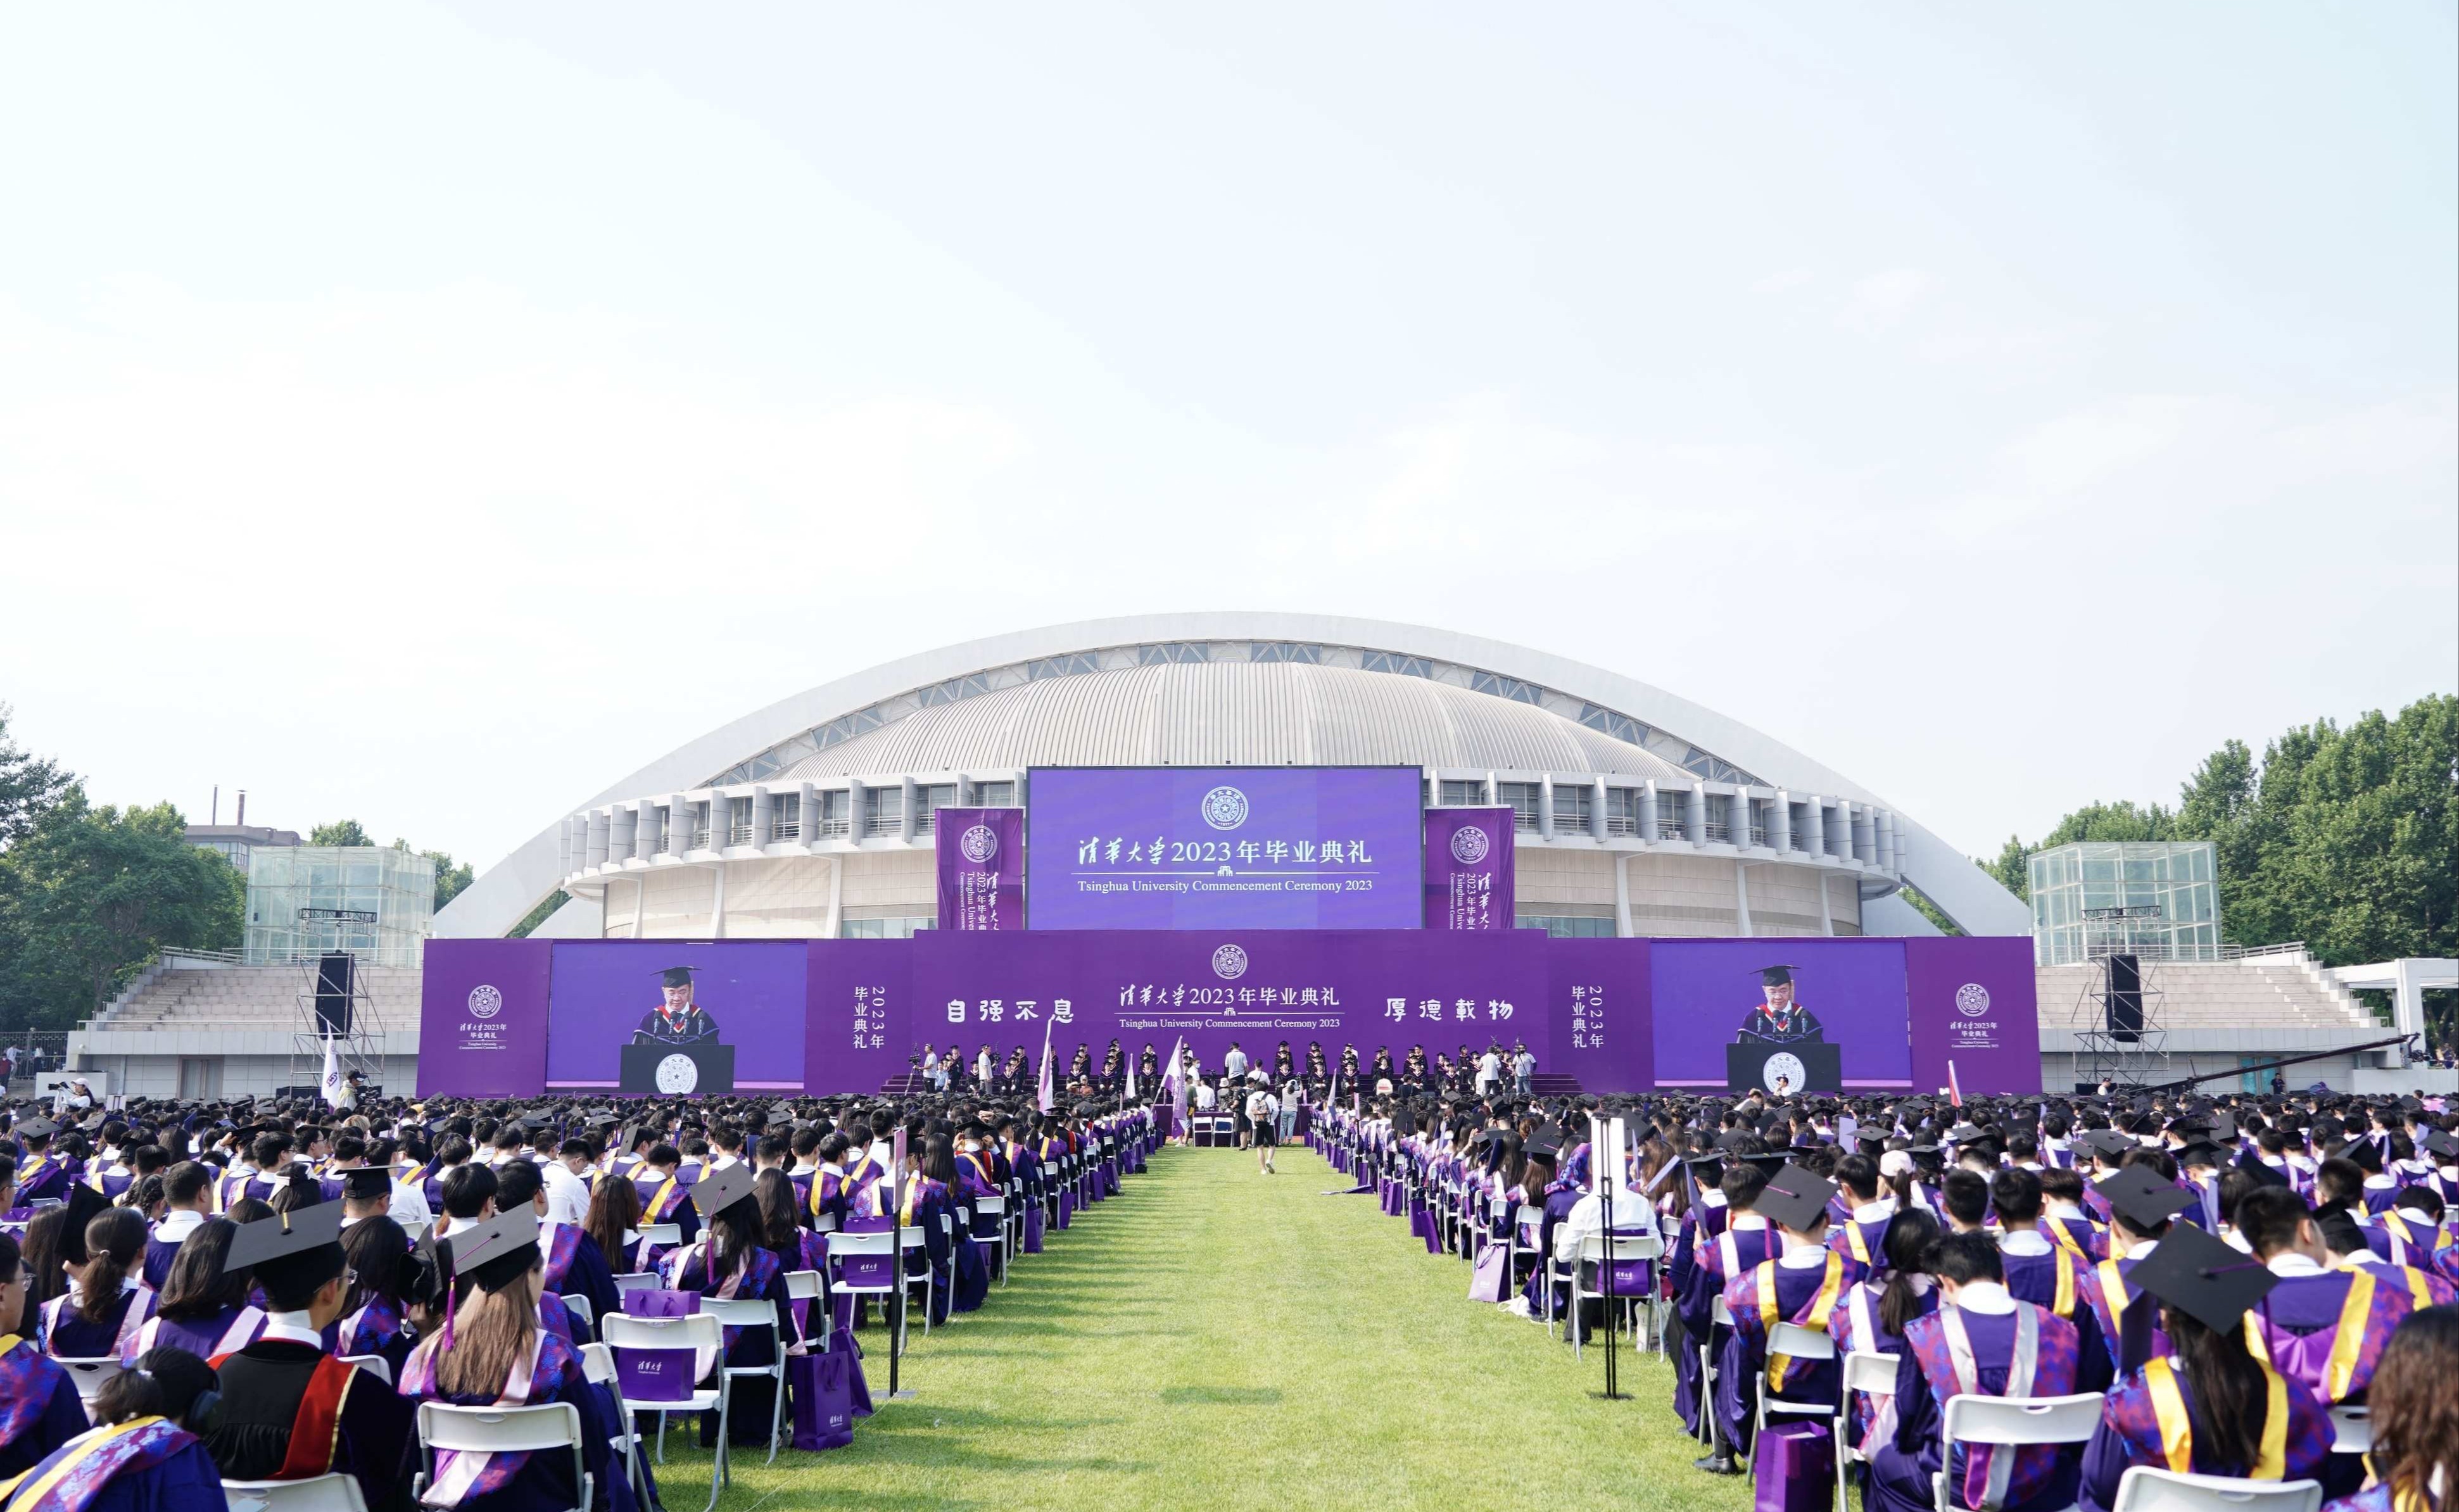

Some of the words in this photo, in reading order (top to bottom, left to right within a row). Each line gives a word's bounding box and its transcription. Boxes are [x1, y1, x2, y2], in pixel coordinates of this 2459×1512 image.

[966, 871, 975, 905] Tsinghua
[1077, 881, 1129, 894] Tsinghua
[1132, 881, 1189, 894] University
[1192, 880, 1282, 891] Commencement
[1284, 880, 1342, 893] Ceremony
[1345, 880, 1372, 890] 2023
[1456, 873, 1465, 906] Tsinghua
[852, 986, 868, 1049] 毕业典礼
[870, 986, 885, 1049] 2023年
[947, 999, 1074, 1024] 自强不息
[1119, 1019, 1158, 1030] Tsinghua
[1160, 1019, 1203, 1030] University
[1205, 1019, 1272, 1028] Commencement
[1274, 1019, 1317, 1030] Ceremony
[1319, 1019, 1340, 1028] 2023
[1571, 986, 1588, 1048] 毕业典礼
[1590, 986, 1604, 1048] 2023年
